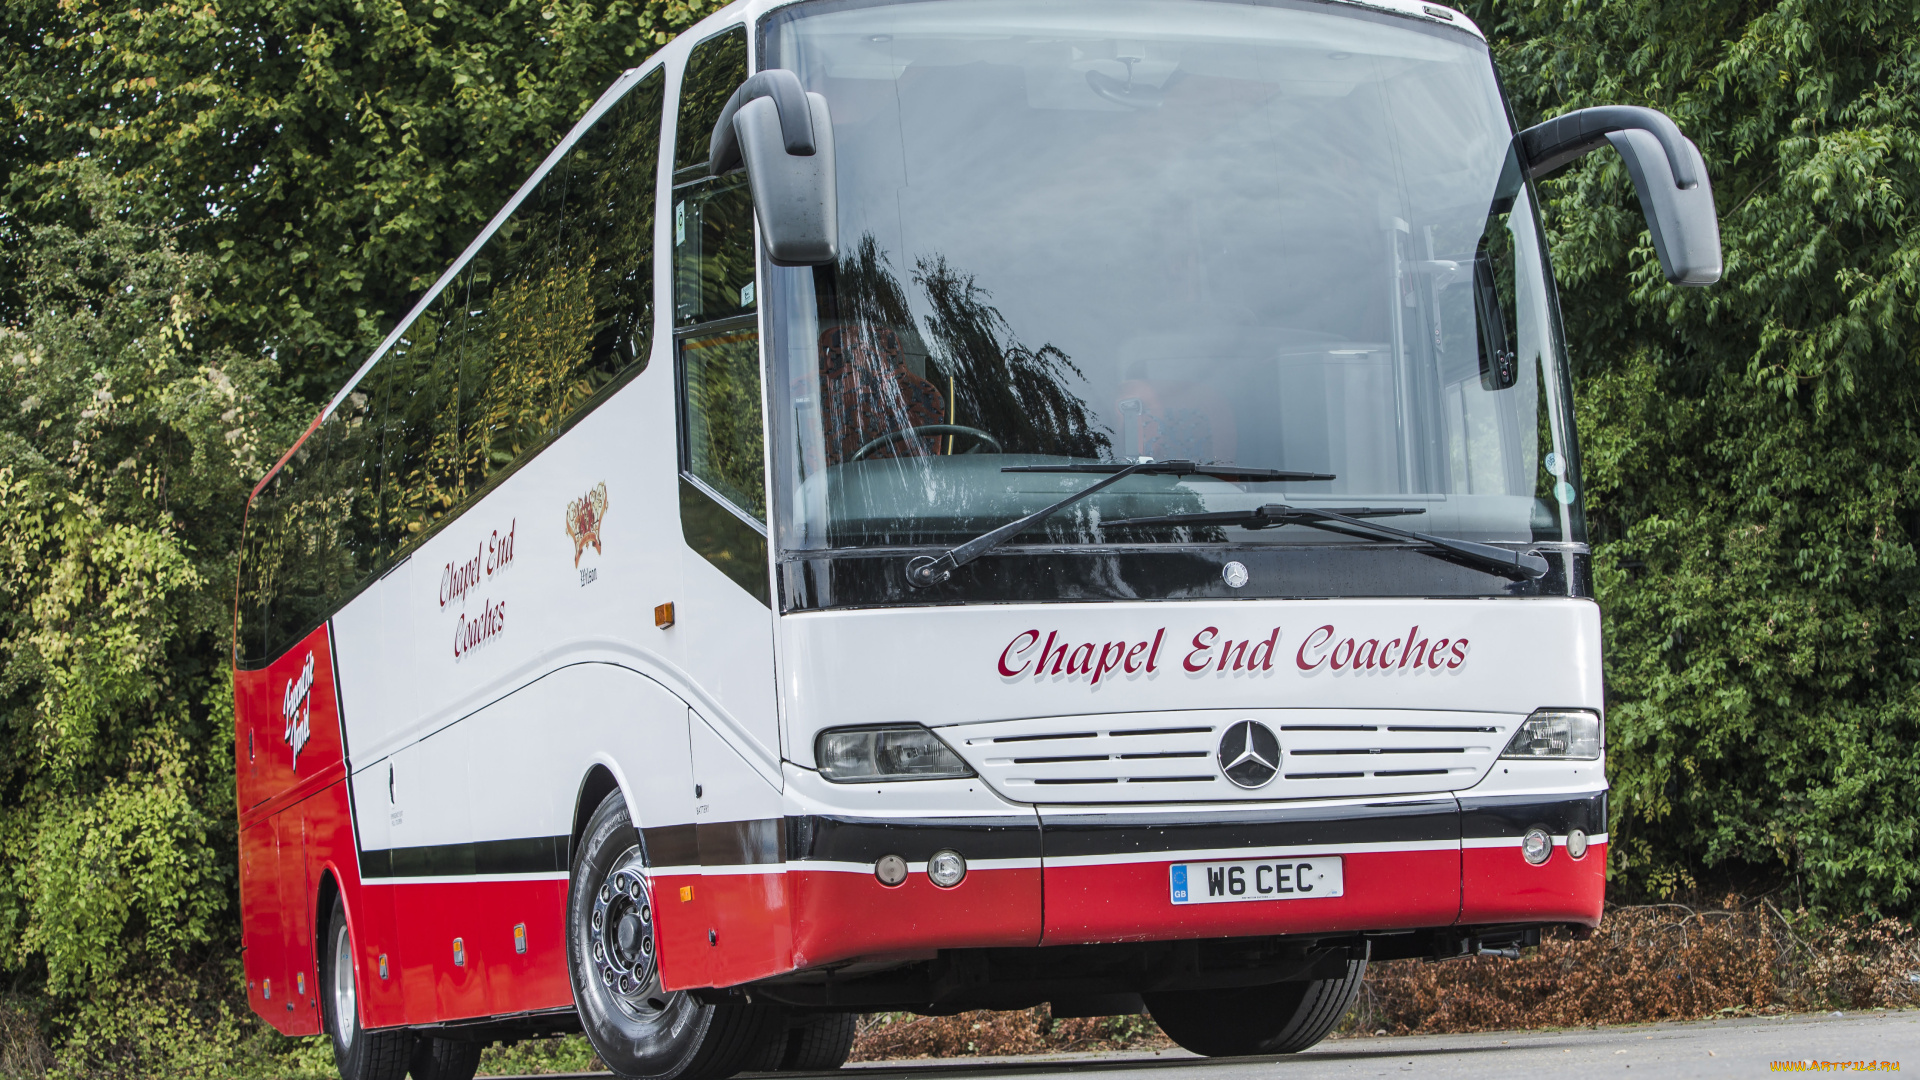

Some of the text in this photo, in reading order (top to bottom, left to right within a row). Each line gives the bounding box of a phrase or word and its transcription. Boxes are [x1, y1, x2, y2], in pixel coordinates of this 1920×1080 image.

[440, 517, 516, 607] Chapel End
[454, 597, 505, 658] Coaches
[997, 625, 1470, 686] Chapel End Coaches
[1174, 890, 1187, 899] GB
[1206, 863, 1314, 897] W6 CEC
